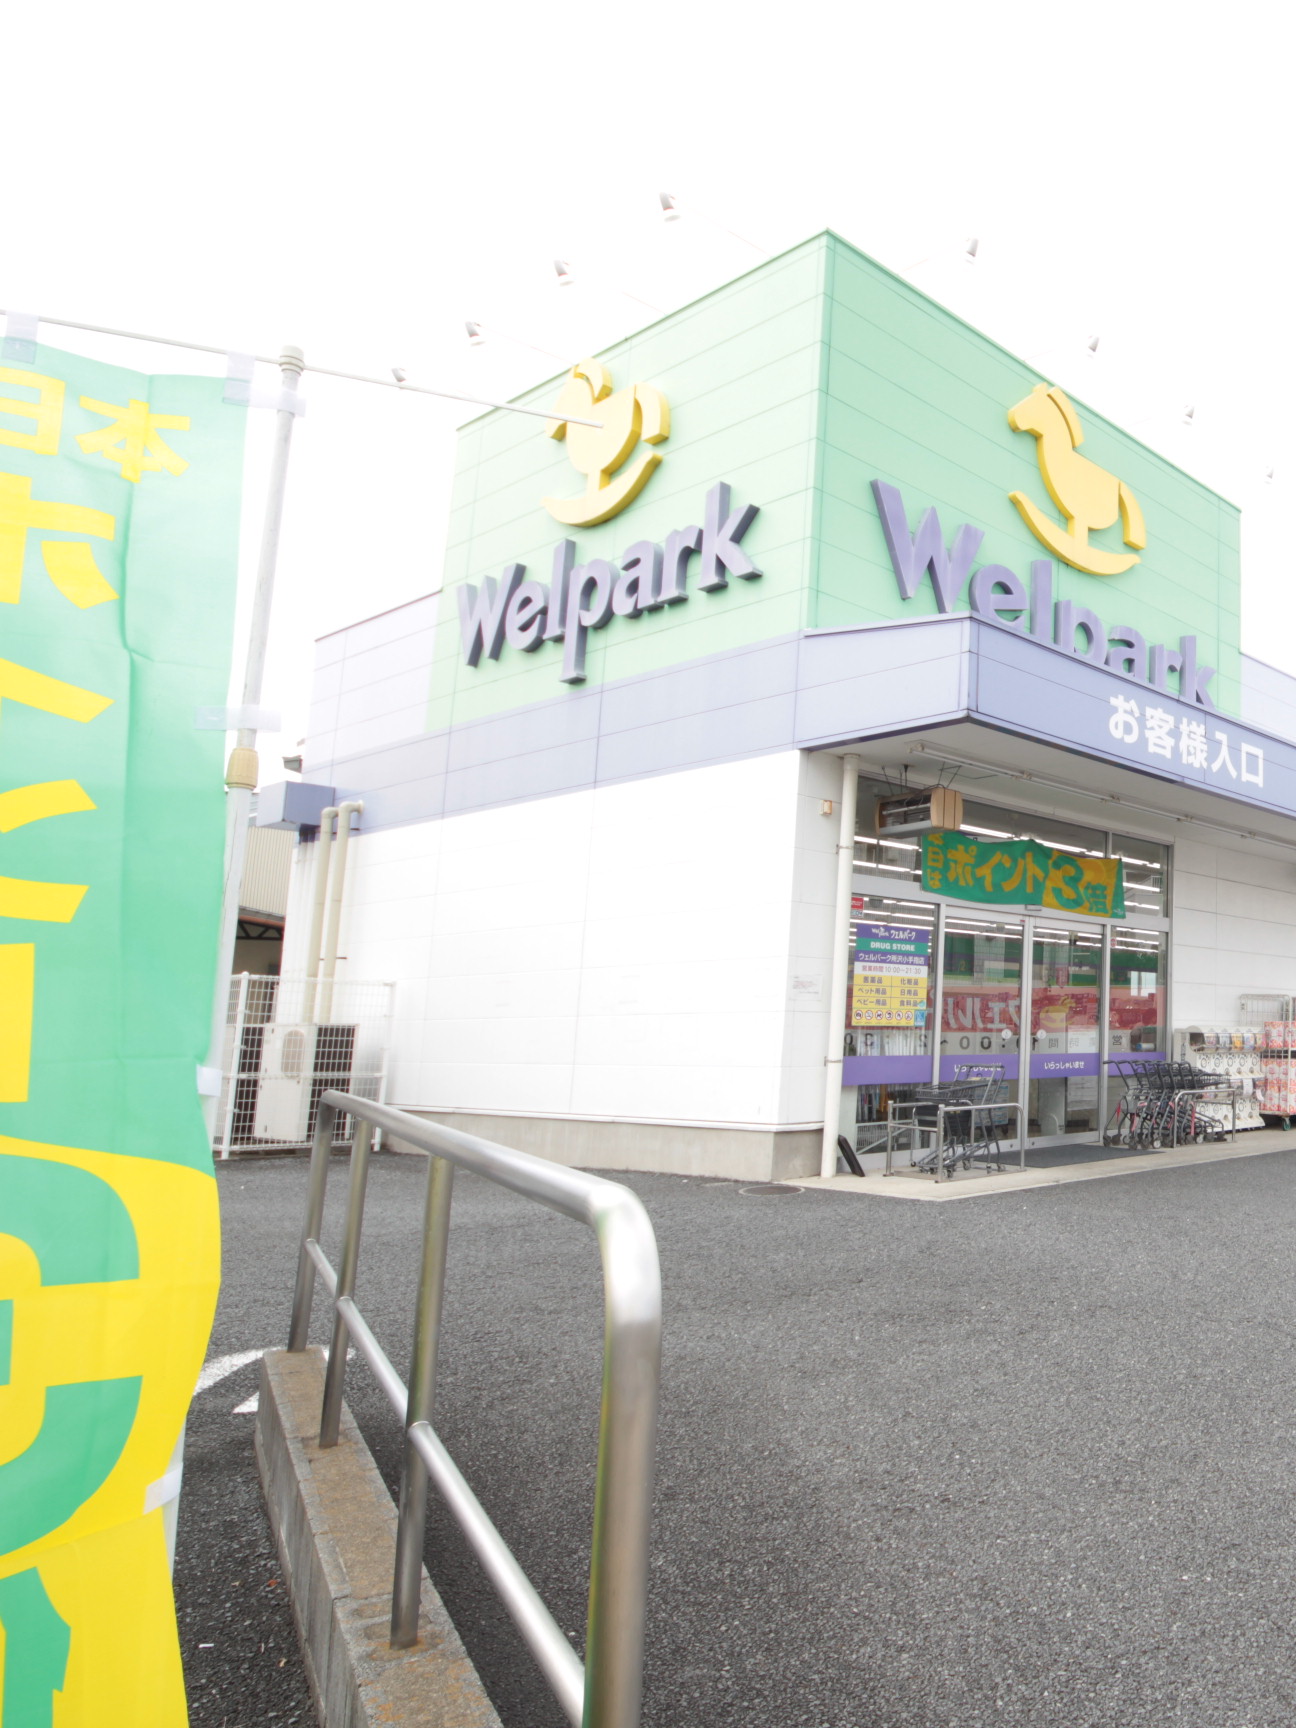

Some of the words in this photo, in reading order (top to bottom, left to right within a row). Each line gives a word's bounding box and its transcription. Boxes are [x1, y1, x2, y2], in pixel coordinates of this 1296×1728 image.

[457, 481, 763, 684] Welpark
[871, 479, 1216, 710] Welpark
[1108, 694, 1265, 788] お客様入口
[870, 941, 891, 950] DRUG
[892, 943, 915, 952] STORE
[900, 989, 919, 997] 日用品
[1044, 1061, 1085, 1070] いらっしゃいませ
